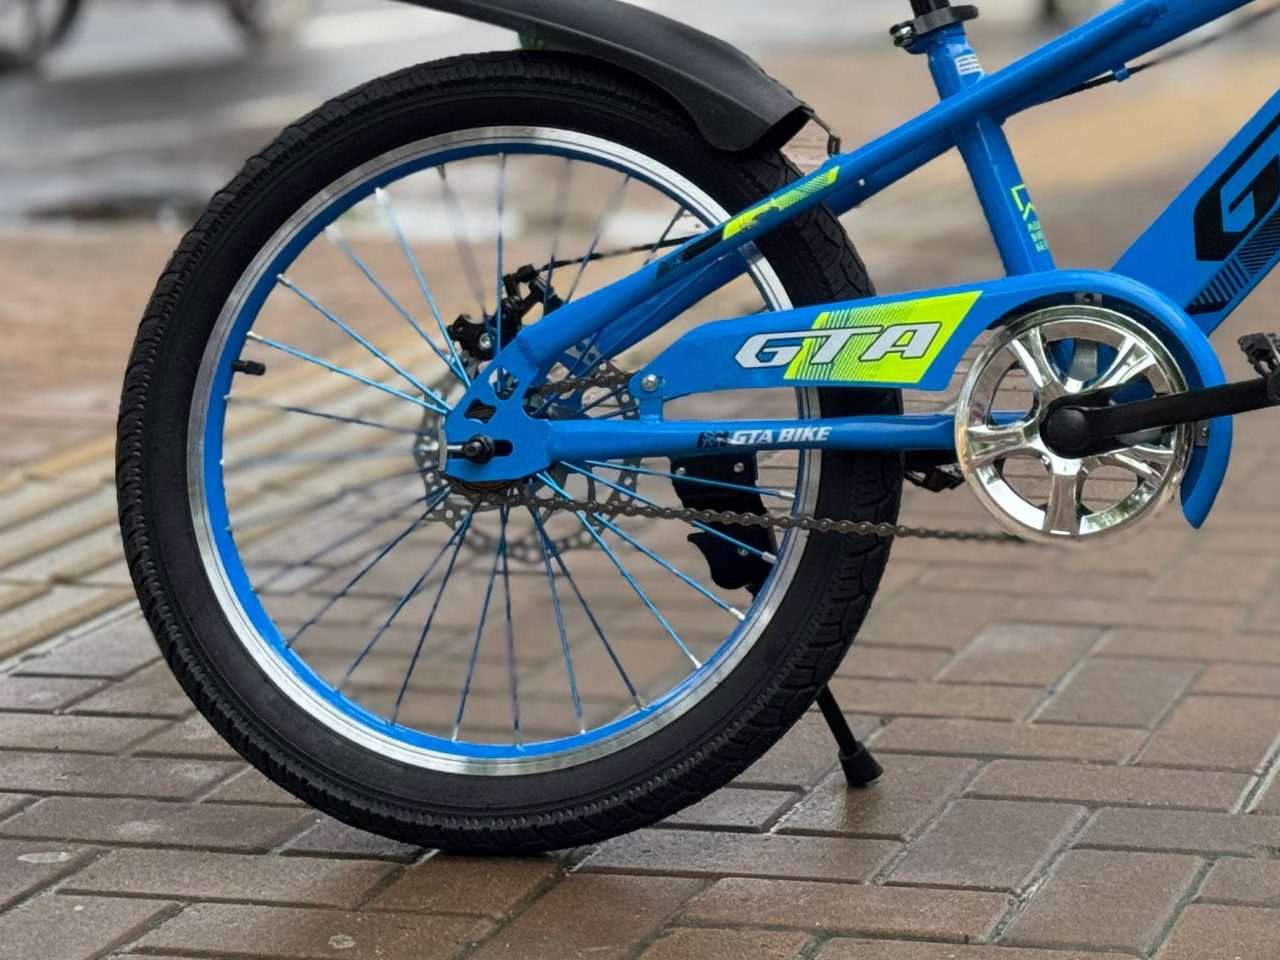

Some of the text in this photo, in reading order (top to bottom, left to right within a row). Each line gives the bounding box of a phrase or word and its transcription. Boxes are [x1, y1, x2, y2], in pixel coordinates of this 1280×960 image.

[734, 321, 942, 368] GTA
[730, 429, 773, 445] GTA
[776, 426, 832, 443] BIKE
